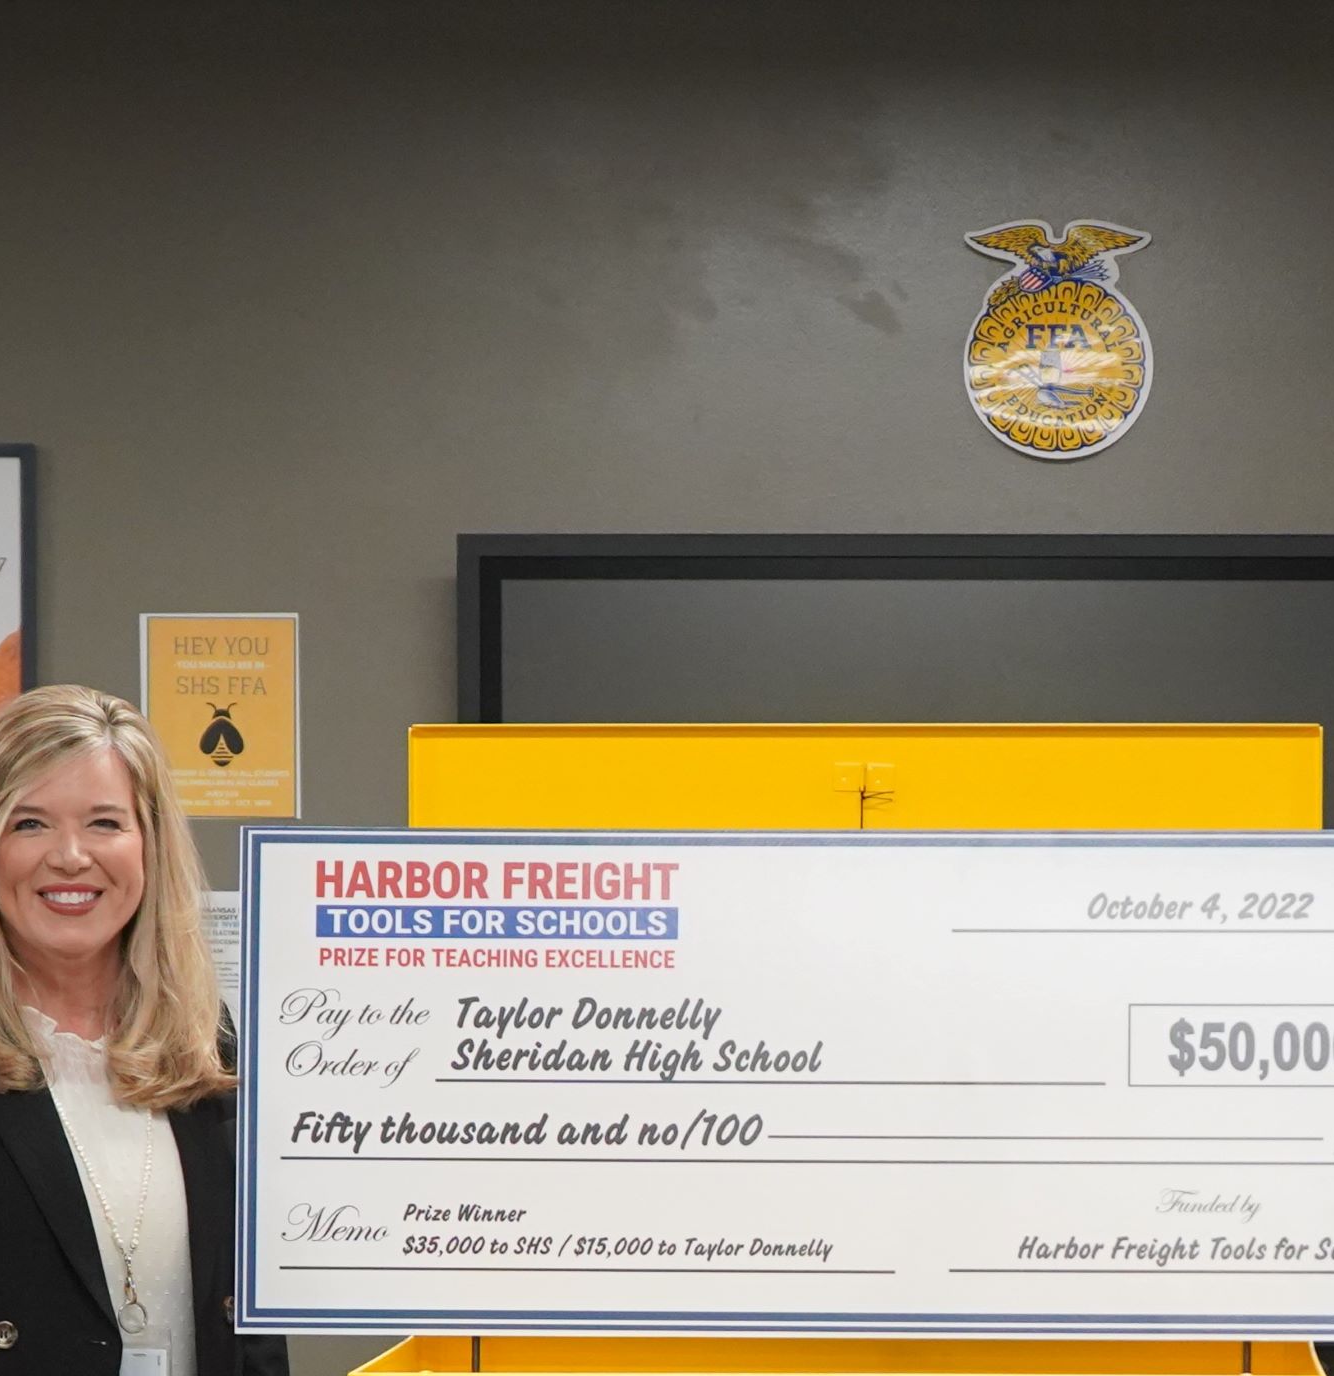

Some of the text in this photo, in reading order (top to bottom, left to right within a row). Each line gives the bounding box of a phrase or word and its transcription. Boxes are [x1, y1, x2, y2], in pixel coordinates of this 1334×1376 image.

[998, 301, 1117, 352] AGRICULTURAL
[1025, 323, 1091, 350] FFA
[1007, 392, 1107, 428] EDUCATION
[174, 636, 270, 656] HEY YOU
[176, 676, 267, 695] SHS FFA
[316, 860, 680, 901] HARBOR FREIGHT
[327, 908, 667, 936] TOOLS FOR SCHOOLS
[1087, 892, 1315, 925] October 4, 2022
[319, 947, 675, 969] PRIZE FOR TEACHING EXCELLENCE
[279, 988, 431, 1041] Pay to the
[456, 995, 722, 1041] Taylor Donnelly
[285, 1040, 421, 1088] Order of
[450, 1037, 824, 1082] Sheridan High School
[290, 1108, 764, 1155] Fifty thousand and no/100
[280, 1202, 391, 1242] Memo
[403, 1203, 527, 1222] Prize Winner
[1155, 1187, 1262, 1224] Funded by
[402, 1234, 834, 1263] $35,000 to SHS / $15,000 to Taylor Donnelly
[1017, 1236, 1104, 1260] Harbor
[1110, 1236, 1200, 1267] Freight
[1210, 1237, 1268, 1260] Tools
[1273, 1237, 1310, 1260] for
